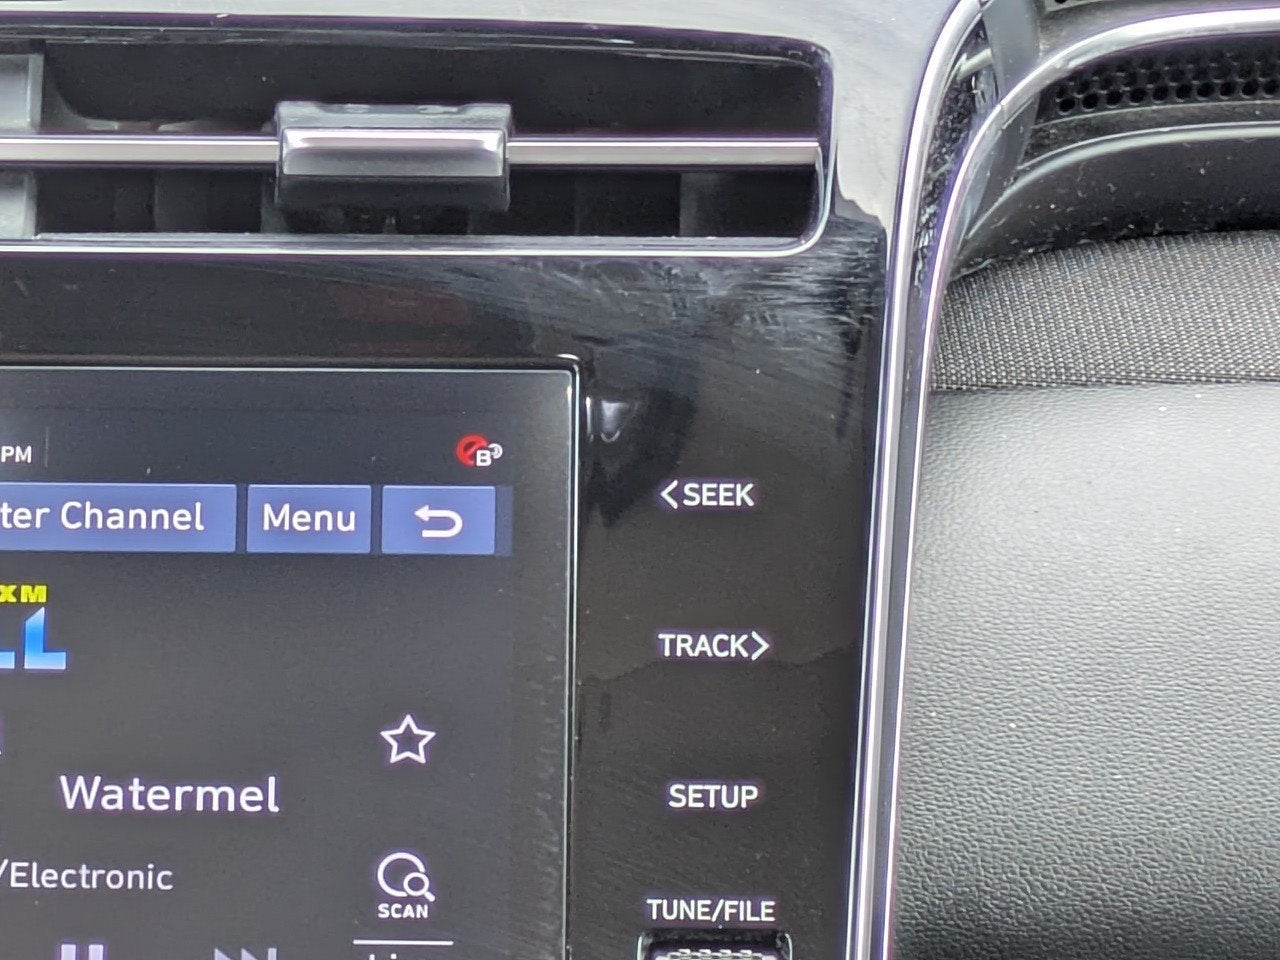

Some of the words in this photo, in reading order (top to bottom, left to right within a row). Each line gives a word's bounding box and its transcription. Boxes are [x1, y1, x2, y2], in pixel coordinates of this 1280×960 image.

[0, 445, 32, 464] PM
[682, 482, 755, 507] SEEK
[61, 500, 205, 531] Channel
[263, 503, 356, 532] Menu
[657, 633, 749, 658] TRACK
[59, 775, 280, 813] Watermel
[668, 783, 759, 809] SETUP
[377, 902, 429, 919] SCAN
[646, 898, 776, 922] TUNE/FILE
